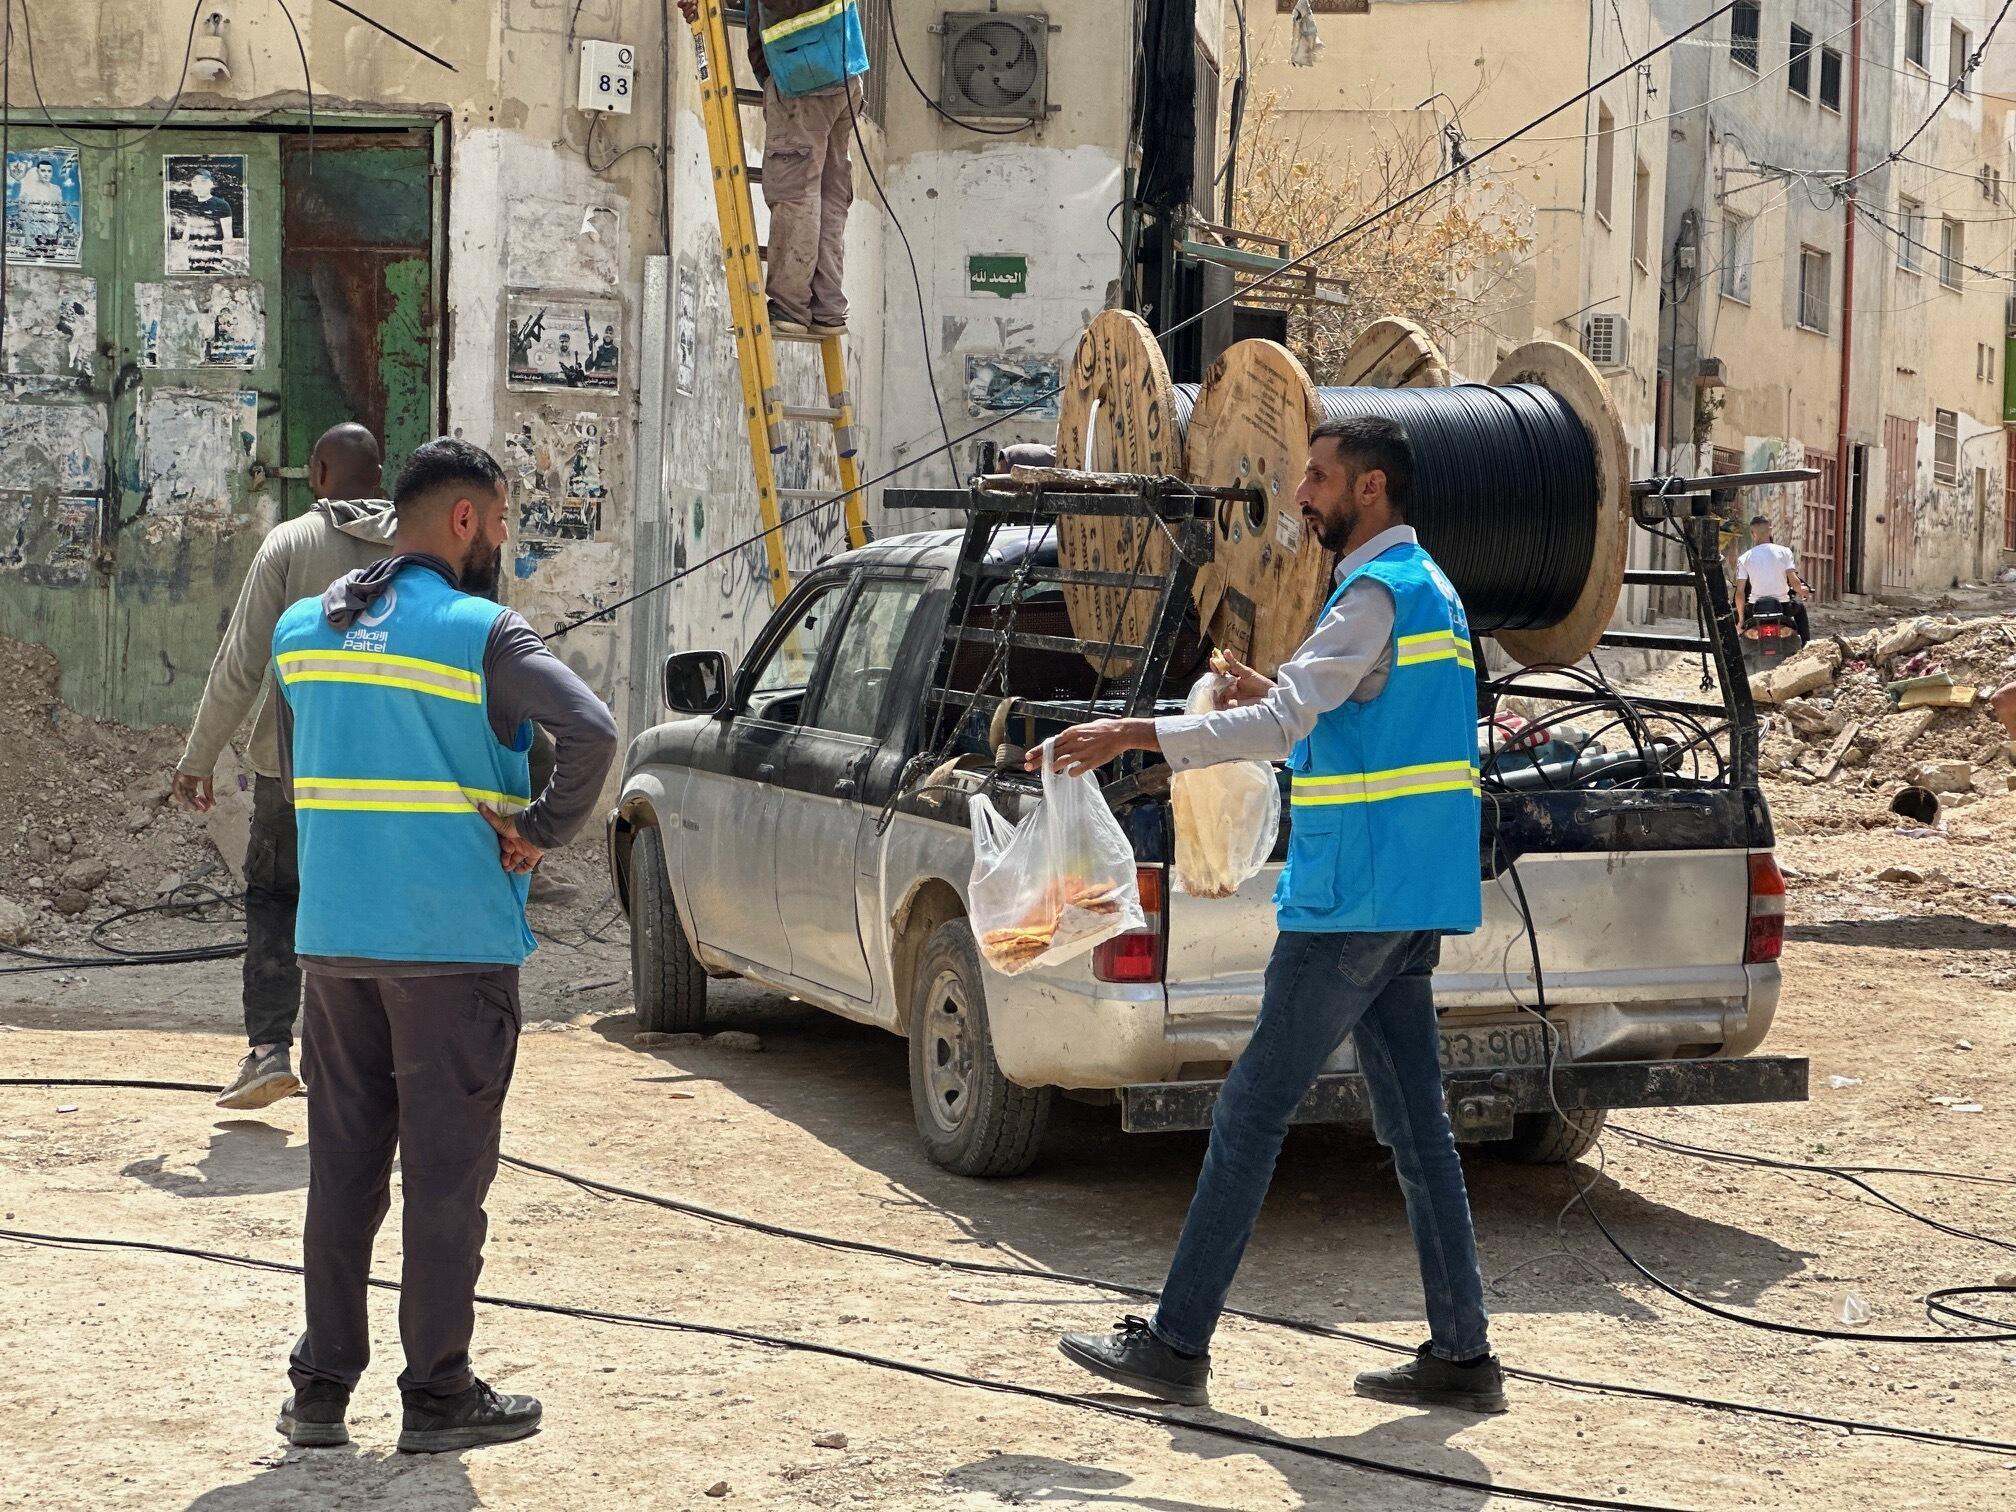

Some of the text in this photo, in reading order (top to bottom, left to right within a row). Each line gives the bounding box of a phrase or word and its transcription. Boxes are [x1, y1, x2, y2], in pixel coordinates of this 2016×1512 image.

[599, 75, 628, 96] 83
[971, 268, 1022, 283] الحمد لله
[1123, 381, 1138, 468] TURKEY
[342, 640, 387, 653] Paltel
